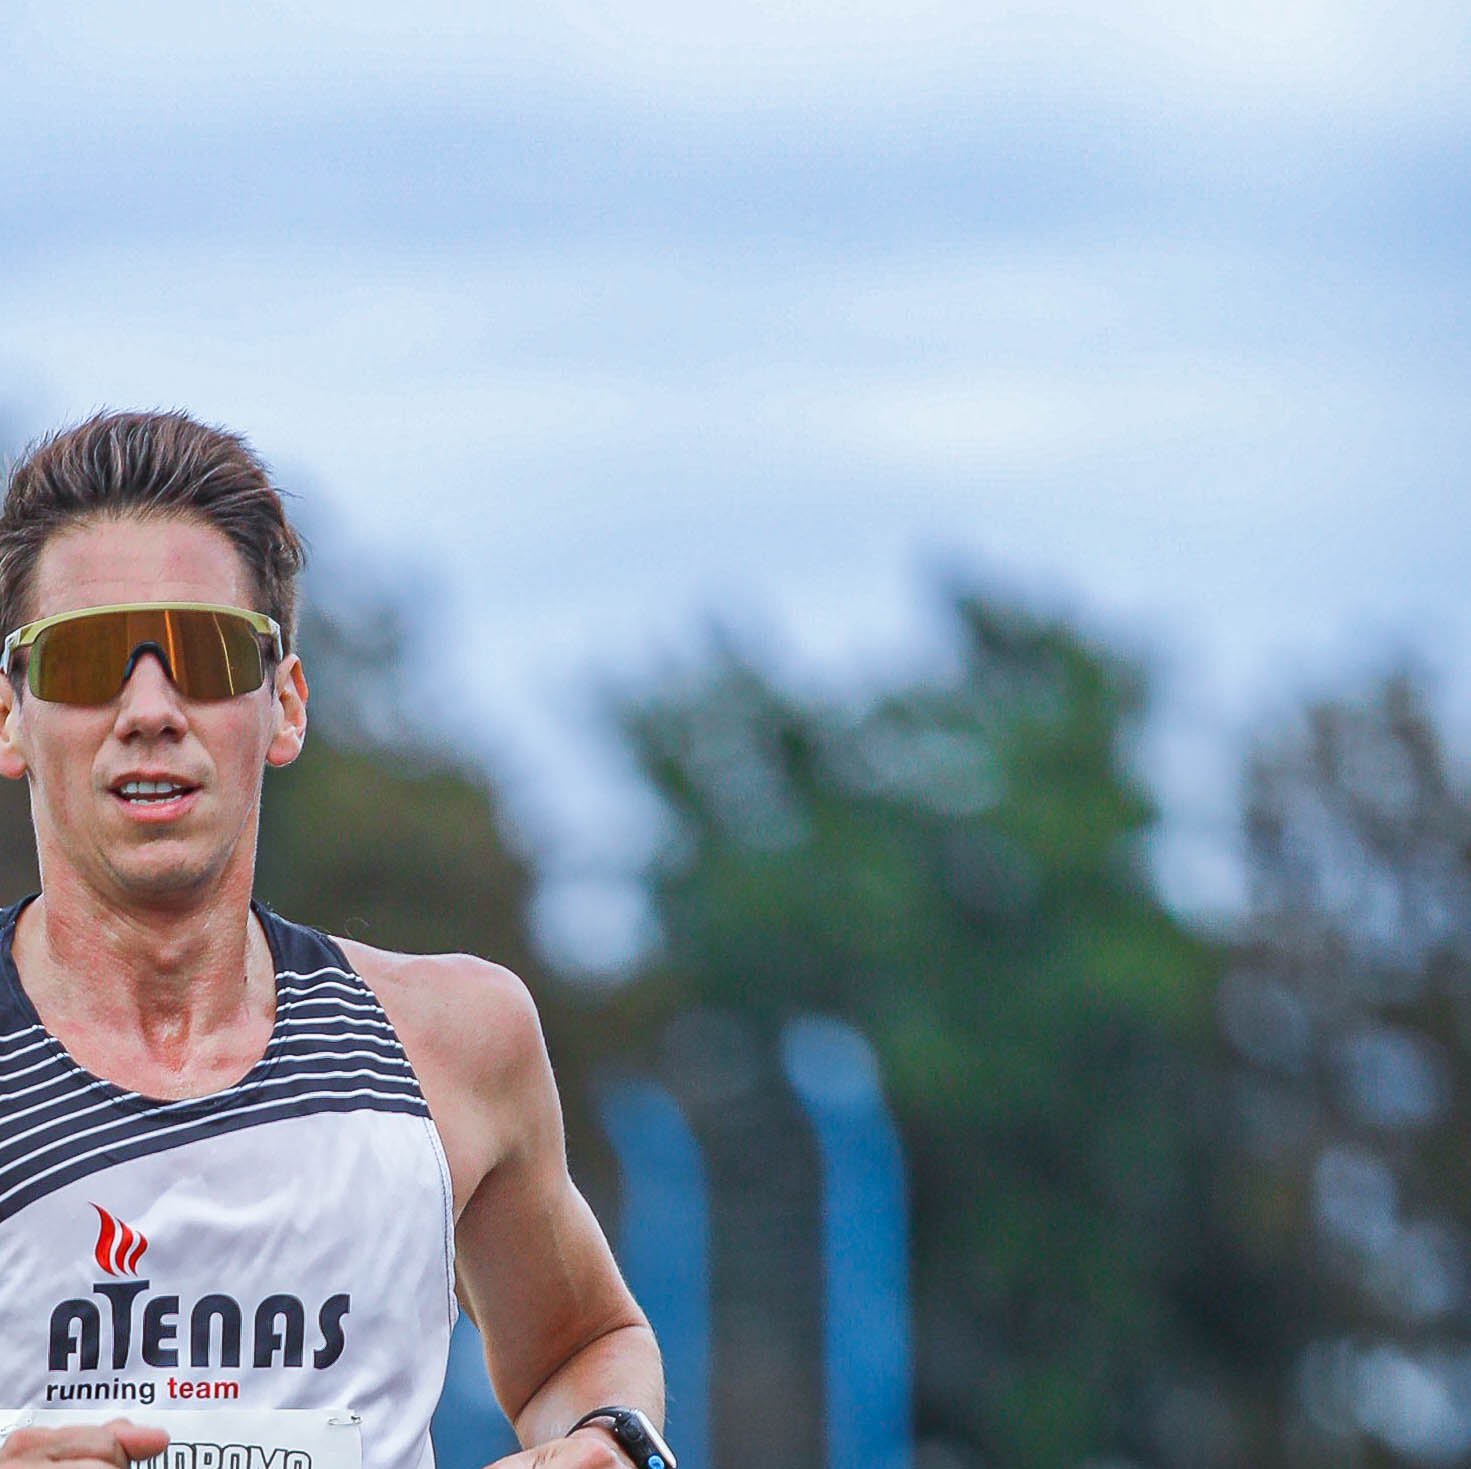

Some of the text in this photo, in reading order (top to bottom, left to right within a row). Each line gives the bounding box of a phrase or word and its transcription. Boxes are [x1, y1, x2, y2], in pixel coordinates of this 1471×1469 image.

[48, 1279, 351, 1372] ATENAS
[46, 1376, 239, 1405] running team
